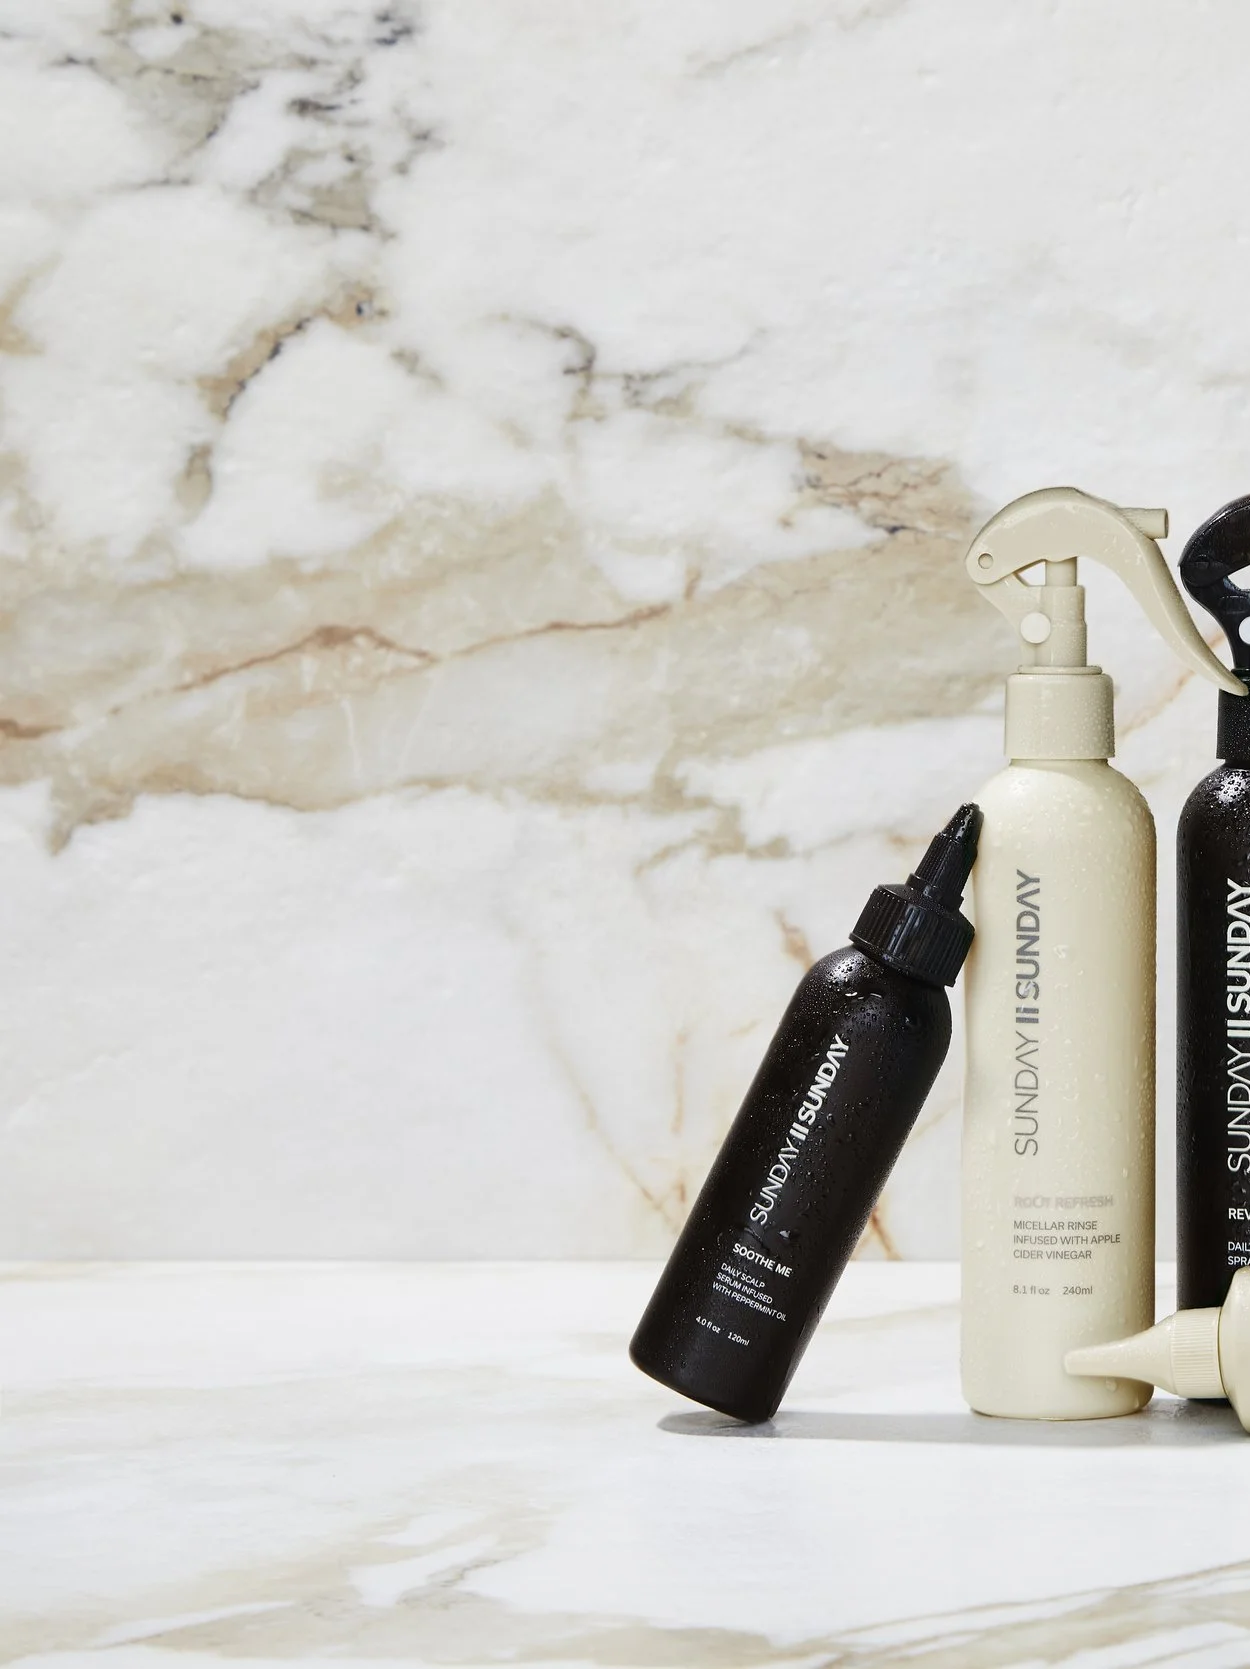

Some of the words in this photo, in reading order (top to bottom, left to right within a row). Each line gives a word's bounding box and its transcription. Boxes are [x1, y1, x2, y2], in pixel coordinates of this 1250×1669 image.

[1015, 868, 1040, 1001] SUNDAY
[1014, 1030, 1039, 1156] SUNDAY
[750, 1137, 800, 1226] SUNDAY
[797, 1033, 849, 1126] SUNDAY
[1055, 1194, 1115, 1209] REFRESH
[1013, 1220, 1065, 1231] MICELLAR
[1067, 1220, 1098, 1231] RINSE
[1013, 1235, 1058, 1246] INFUSED
[1059, 1235, 1088, 1245] WITH
[1090, 1233, 1121, 1245] APPLE
[732, 1243, 776, 1270] SOOTHE
[775, 1263, 793, 1278] ME
[1013, 1249, 1043, 1260] CIDER
[1045, 1250, 1092, 1260] VINEGAR
[716, 1272, 742, 1290] SERUM
[741, 1285, 773, 1304] INFUSED
[720, 1262, 742, 1278] DAILY
[740, 1273, 766, 1289] SCALP
[712, 1281, 732, 1297] WITH
[731, 1291, 777, 1317] PEPPERMINT
[776, 1311, 787, 1322] OIL
[1013, 1284, 1028, 1295] 8.1
[1030, 1285, 1037, 1295] fl
[1038, 1286, 1050, 1295] oz
[1062, 1285, 1093, 1296] 240ml
[712, 1325, 721, 1334] oz
[727, 1331, 750, 1346] 120ml
